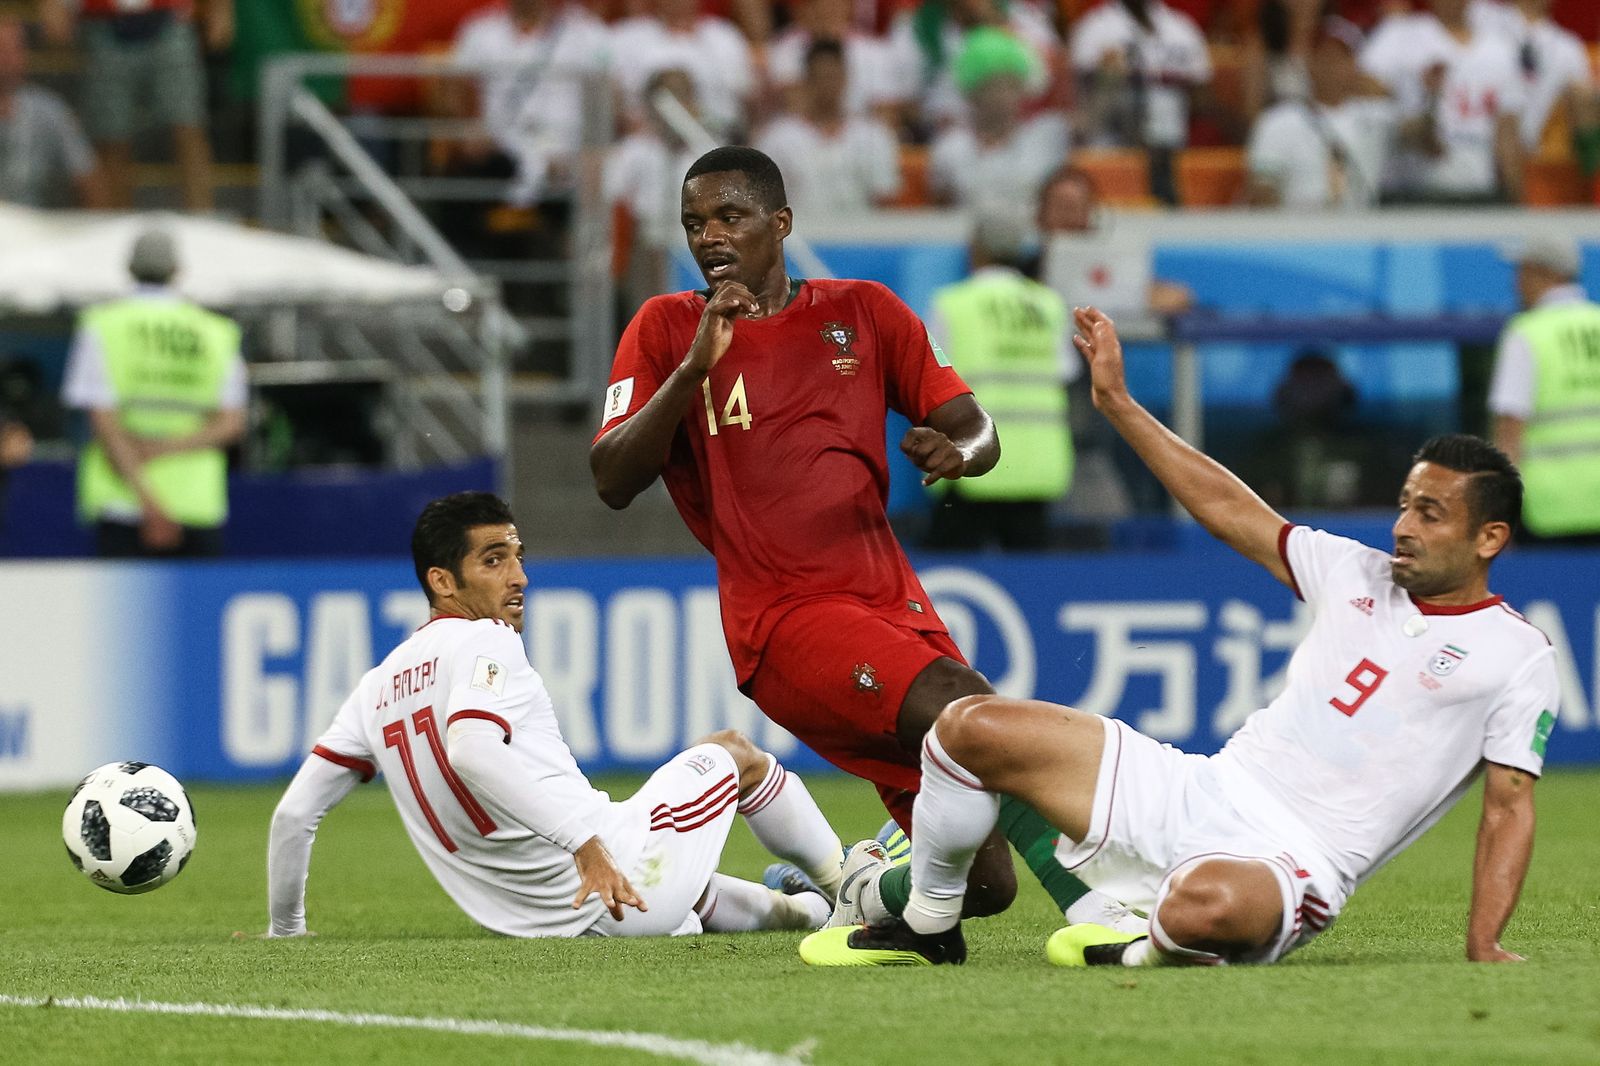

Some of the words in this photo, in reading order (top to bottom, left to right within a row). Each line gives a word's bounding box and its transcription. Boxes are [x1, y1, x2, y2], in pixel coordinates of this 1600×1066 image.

[702, 372, 753, 436] 14
[1329, 657, 1390, 717] 9
[383, 705, 499, 854] 11
